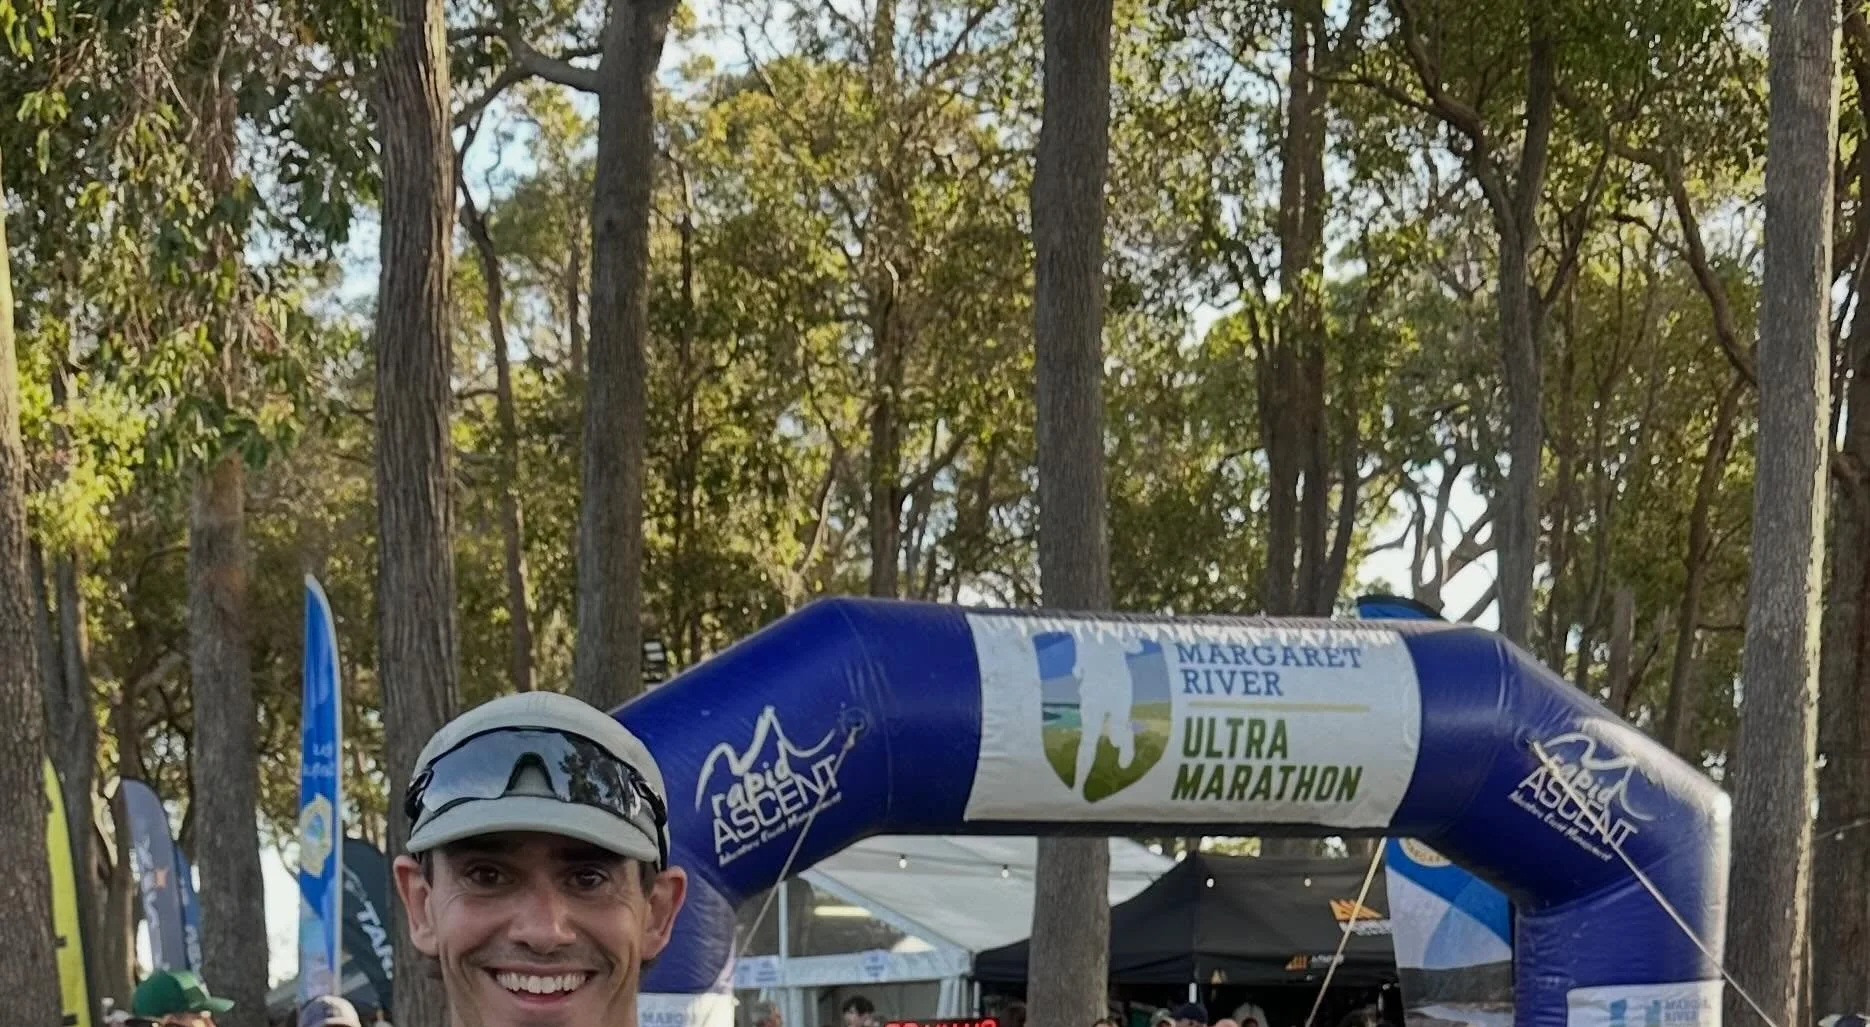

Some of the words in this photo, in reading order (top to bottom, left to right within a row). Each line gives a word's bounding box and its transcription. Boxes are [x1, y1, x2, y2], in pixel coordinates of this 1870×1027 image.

[1174, 641, 1362, 669] MARGARET
[1180, 668, 1284, 697] RIVER
[1182, 716, 1289, 760] ULTRA
[711, 739, 793, 818] rapid
[1170, 763, 1364, 803] MARATHON
[712, 753, 838, 855] ASCENT
[1517, 764, 1639, 850] ASCENT
